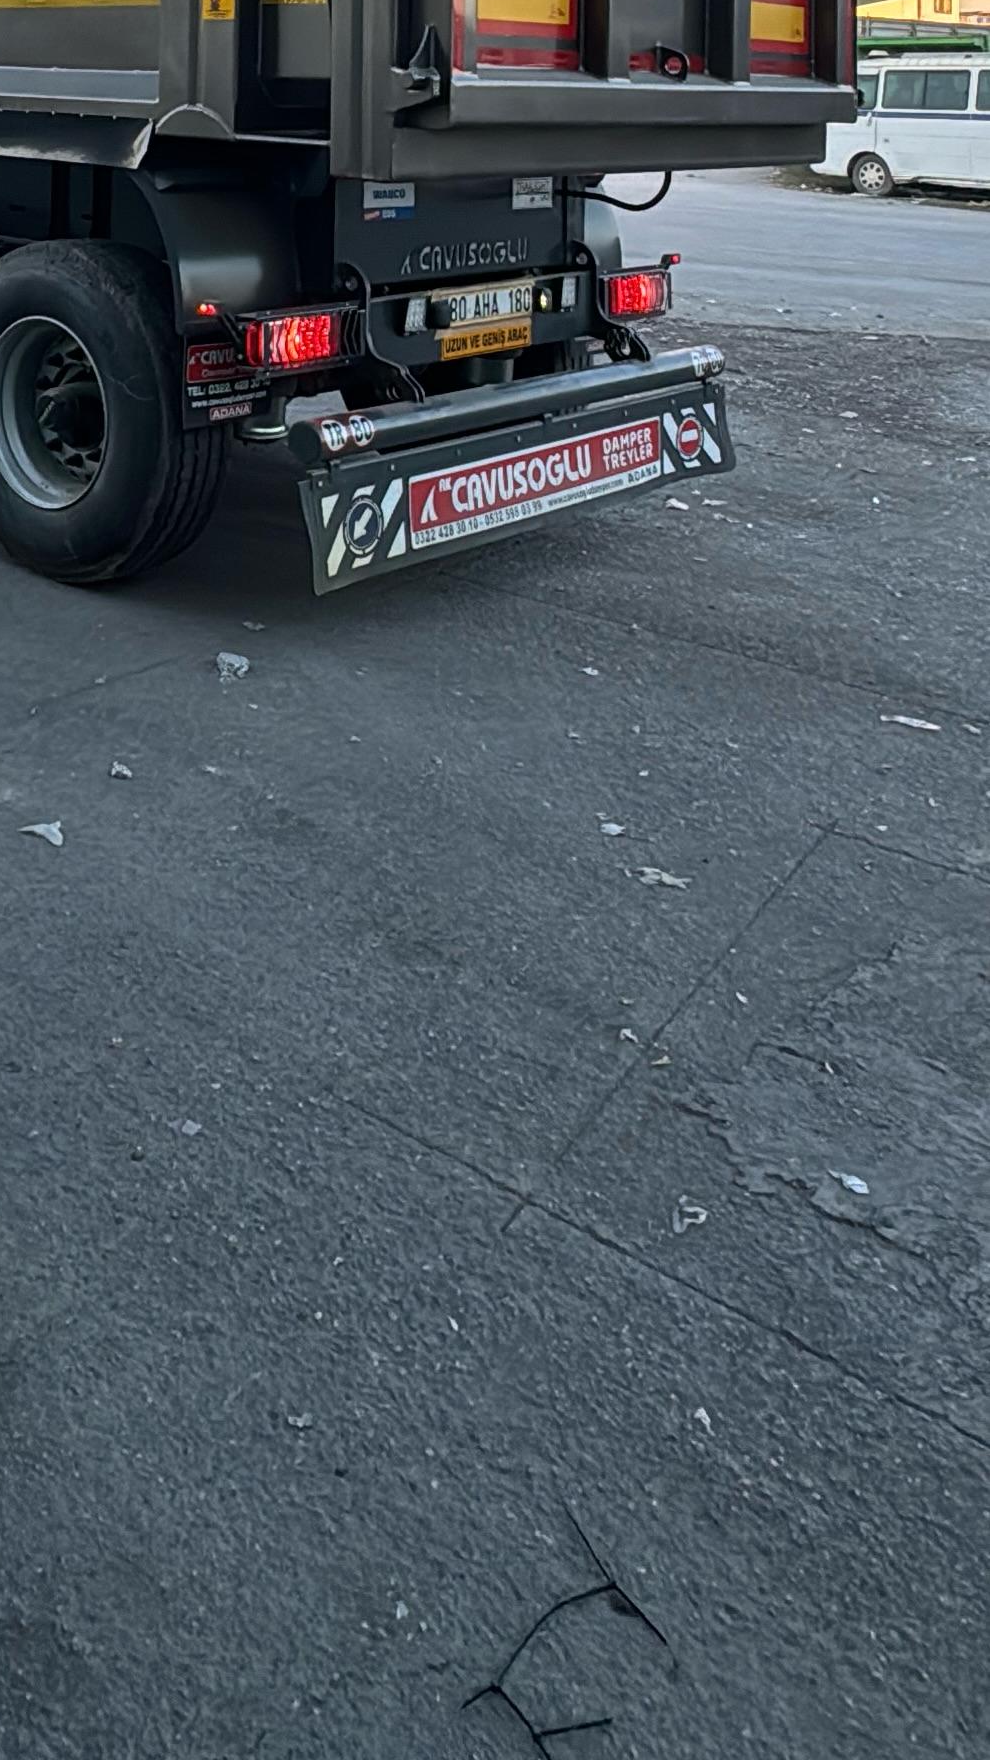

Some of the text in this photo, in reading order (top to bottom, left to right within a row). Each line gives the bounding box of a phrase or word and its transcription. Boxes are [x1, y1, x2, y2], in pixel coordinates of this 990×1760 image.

[420, 239, 528, 271] CAVUSOGLU
[450, 287, 531, 322] 80 AHA 180
[445, 335, 468, 353] UZUN
[470, 334, 480, 348] VE
[213, 404, 251, 419] ADANA
[322, 417, 373, 447] TR 80
[602, 427, 651, 455] DAMPER
[602, 442, 653, 472] TREYLER
[452, 443, 592, 513] CAVUSOGLU
[627, 463, 658, 484] ADANA
